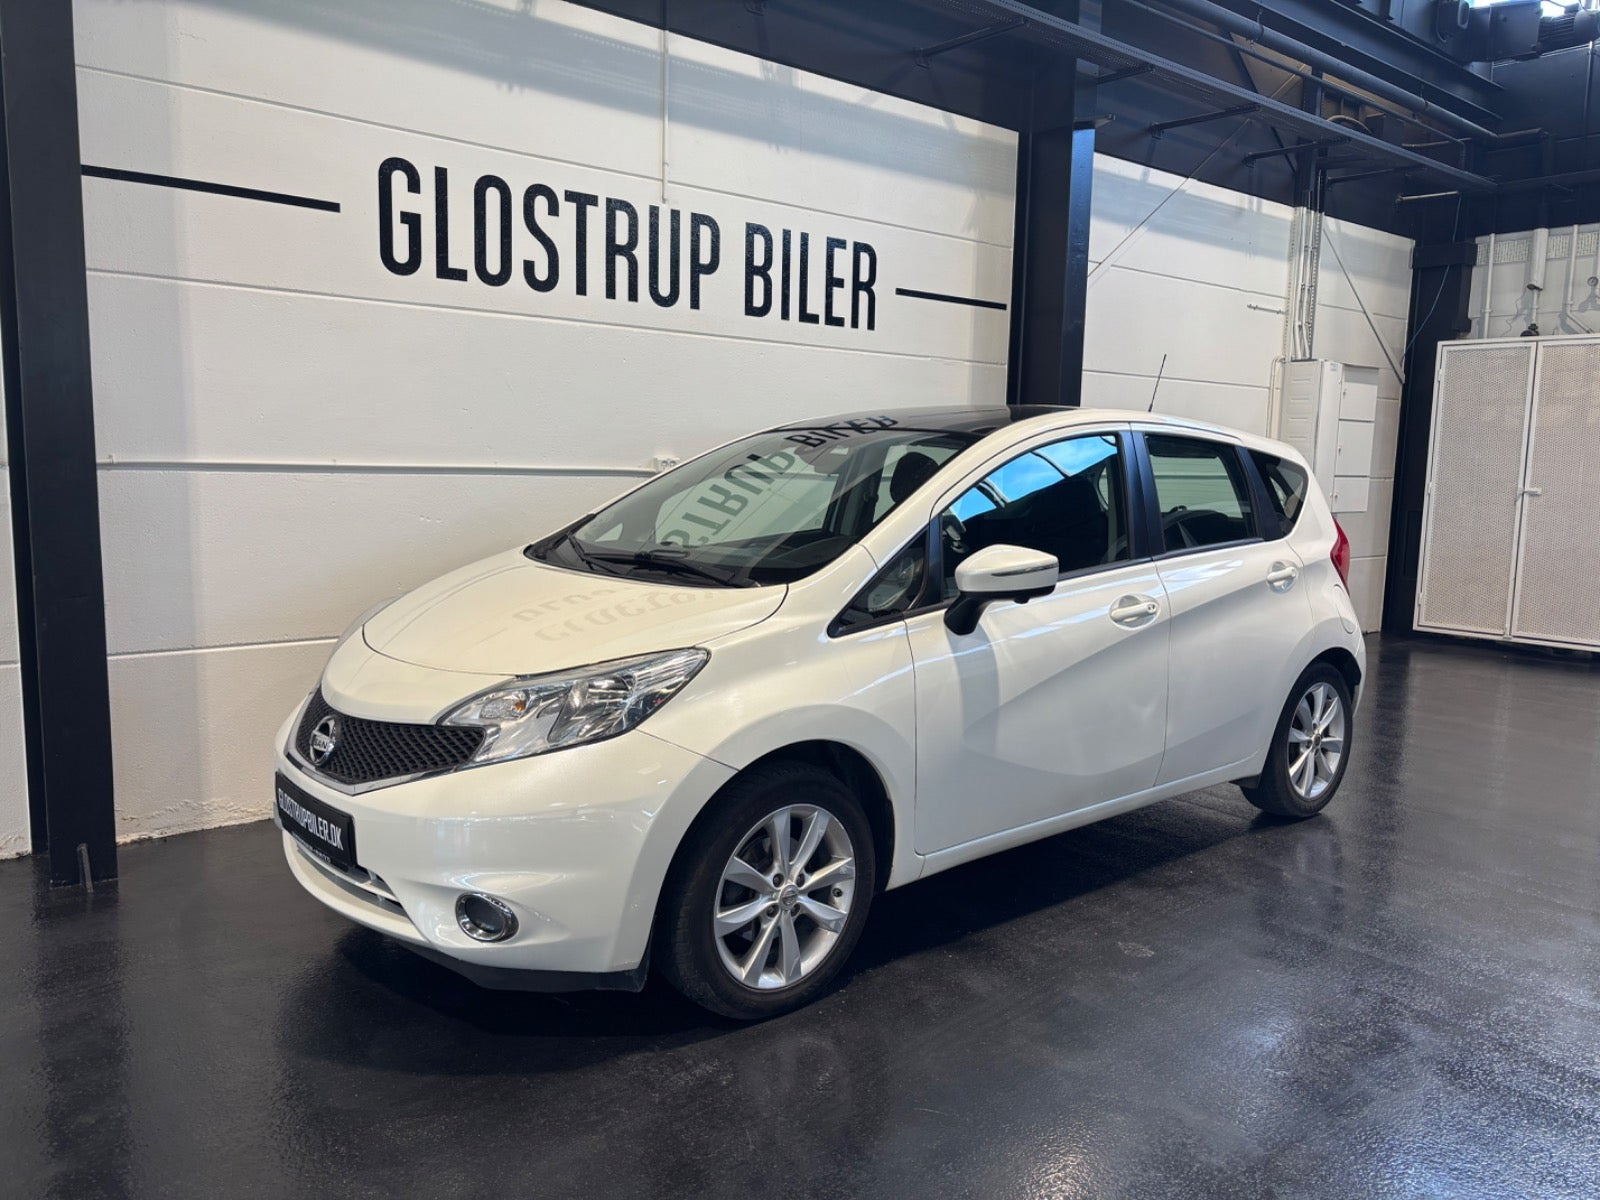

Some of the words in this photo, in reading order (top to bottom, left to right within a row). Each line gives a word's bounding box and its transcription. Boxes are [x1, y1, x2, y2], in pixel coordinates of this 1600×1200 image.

[378, 156, 720, 310] GLOSTRUP
[744, 222, 877, 331] BILER
[278, 788, 344, 851] GLOSTRUPBILER.DK
